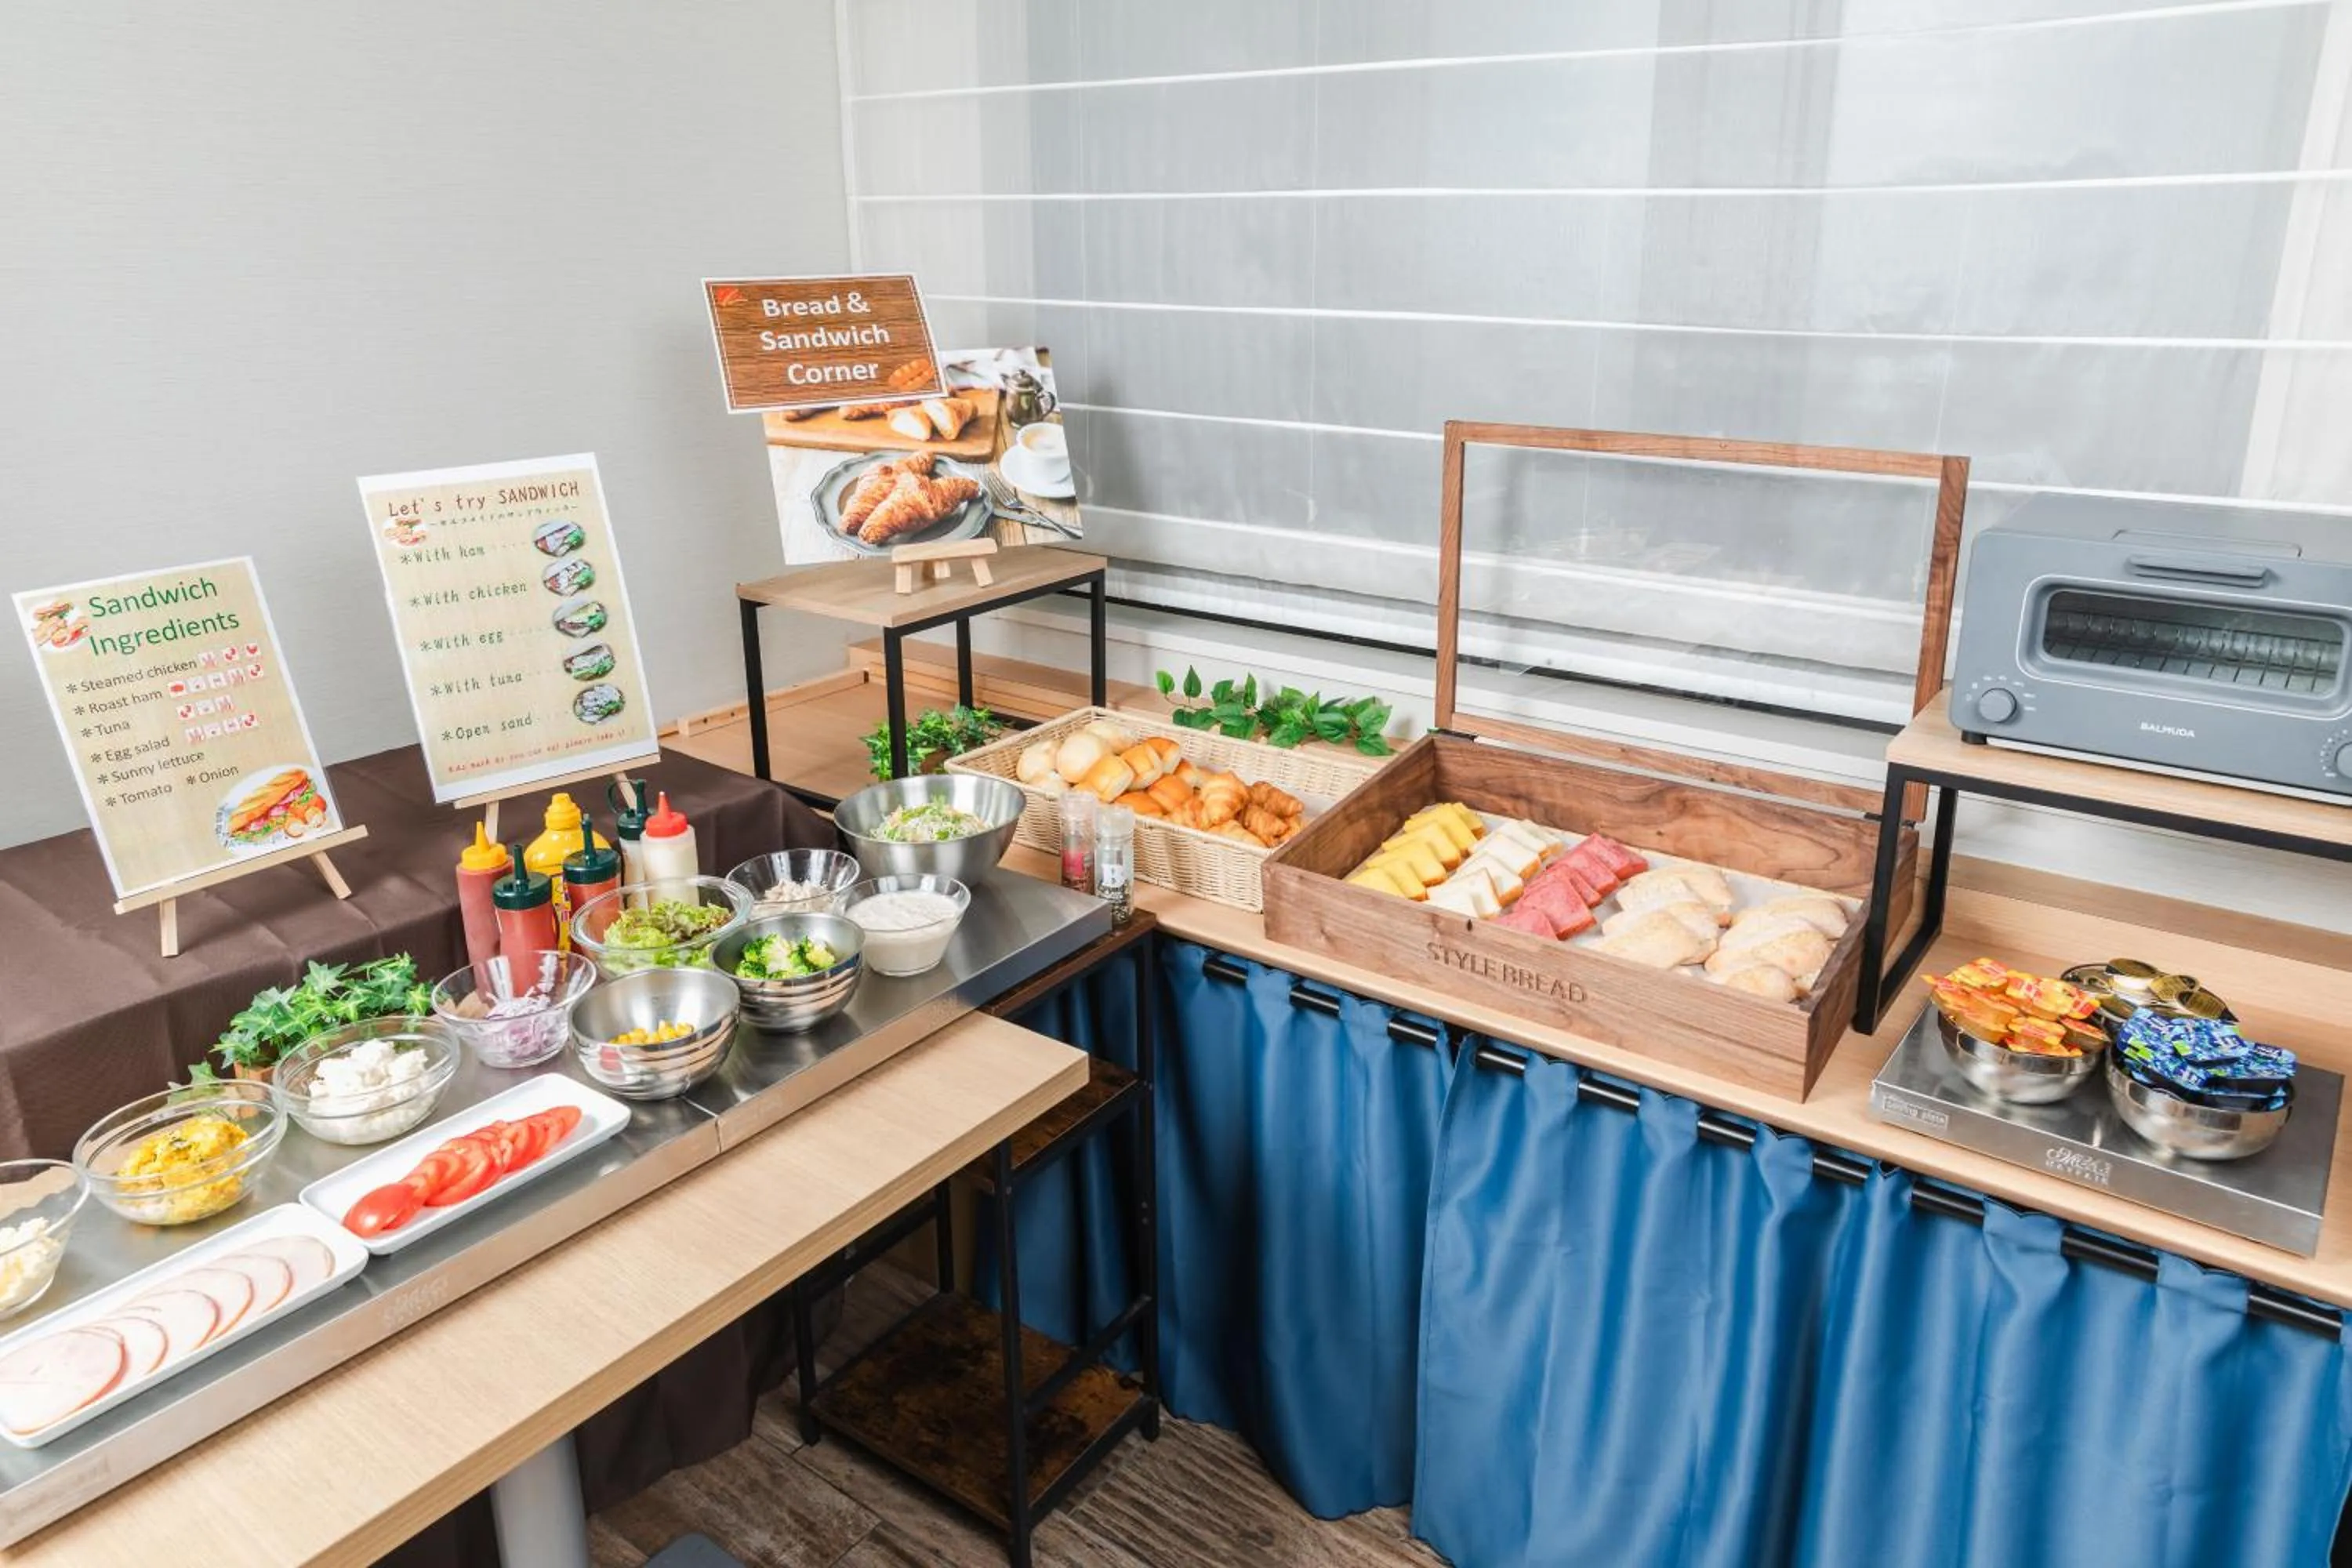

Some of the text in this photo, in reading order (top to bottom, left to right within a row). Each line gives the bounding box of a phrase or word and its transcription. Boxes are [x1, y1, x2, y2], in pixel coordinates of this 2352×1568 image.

[761, 292, 871, 319] Bread &
[759, 324, 891, 352] Sandwich
[787, 360, 879, 386] Corner
[388, 481, 579, 517] Let's try SANDWICH
[414, 545, 485, 562] With ham
[88, 577, 219, 619] Sandwich
[423, 583, 528, 605] With chicken
[89, 612, 241, 656] Ingredients
[434, 630, 504, 650] With egg
[81, 659, 198, 692] Steamed chicken
[443, 672, 523, 695] With tuna
[89, 689, 164, 714] Roast ham
[94, 720, 131, 736] Tuna
[456, 711, 533, 742] Open sand
[2140, 720, 2195, 738] BALMUDA
[104, 736, 171, 762] Egg salad
[111, 750, 206, 784] Sunny lettuce
[198, 765, 240, 784] Onion
[120, 784, 173, 805] Tomato
